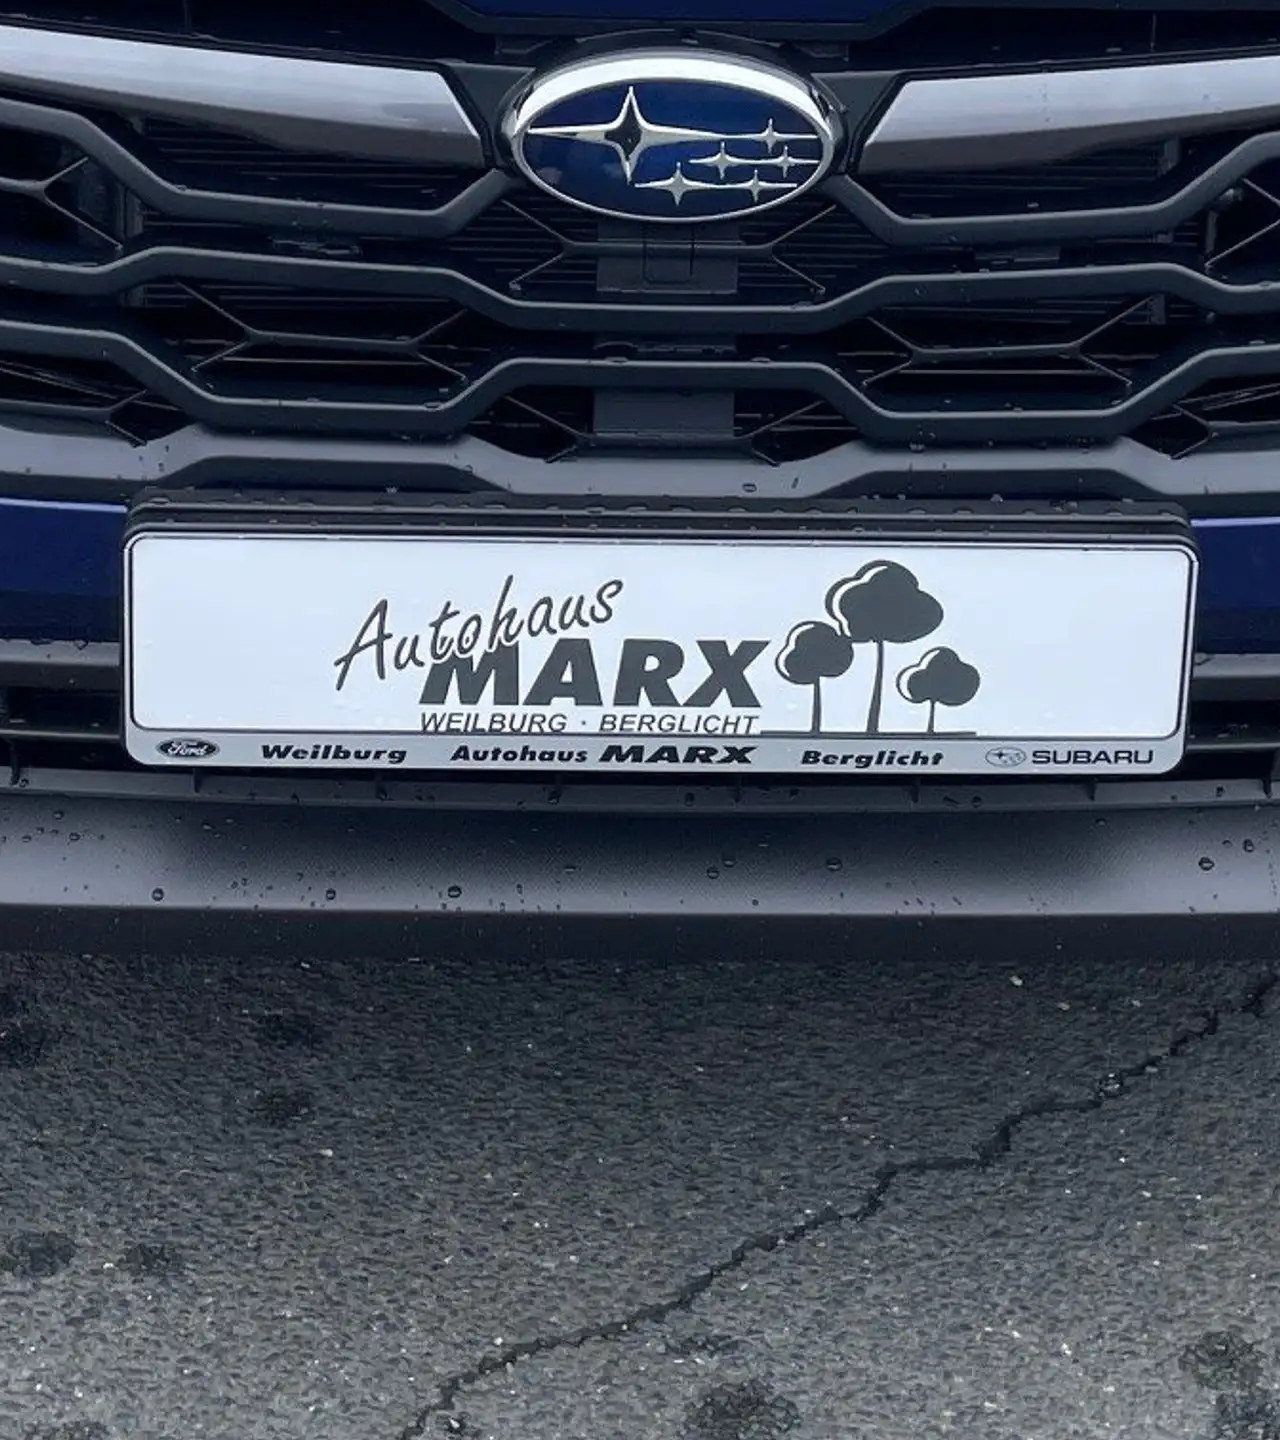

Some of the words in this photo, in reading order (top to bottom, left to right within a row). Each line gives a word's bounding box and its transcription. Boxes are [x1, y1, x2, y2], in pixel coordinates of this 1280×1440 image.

[334, 574, 624, 691] Autohaus
[419, 638, 771, 708] MARX
[420, 712, 569, 733] WEILBURG
[599, 713, 761, 736] BERGLICHT
[167, 740, 209, 757] Ford
[261, 743, 407, 764] Weilburg
[451, 744, 589, 763] Autohaus
[599, 744, 759, 765] MARX
[801, 749, 944, 770] Berglicht
[1032, 749, 1154, 765] SUBARU
